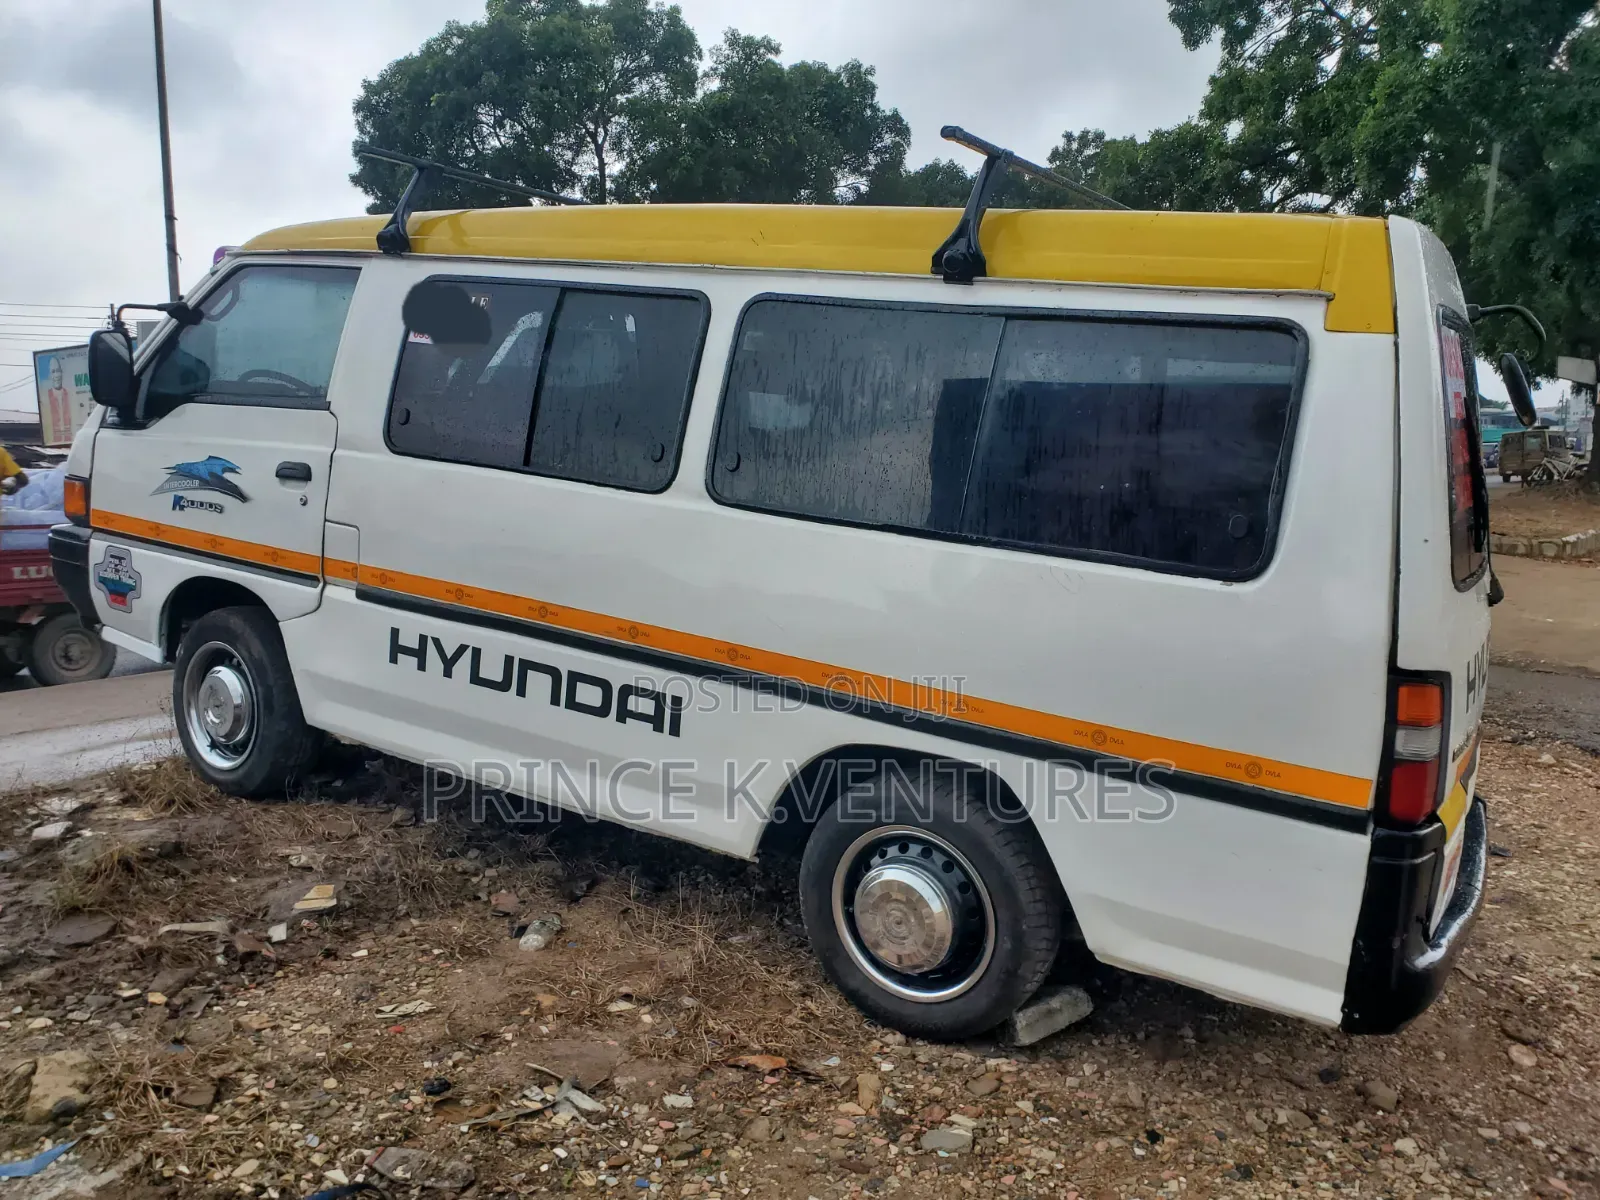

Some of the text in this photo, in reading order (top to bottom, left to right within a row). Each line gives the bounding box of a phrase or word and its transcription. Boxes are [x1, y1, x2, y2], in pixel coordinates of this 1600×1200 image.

[163, 480, 200, 489] INTERCOOLER
[389, 626, 683, 738] HYUNDAI
[1074, 729, 1125, 746] DVLA DVLA
[1225, 761, 1282, 778] DVLA DVLA
